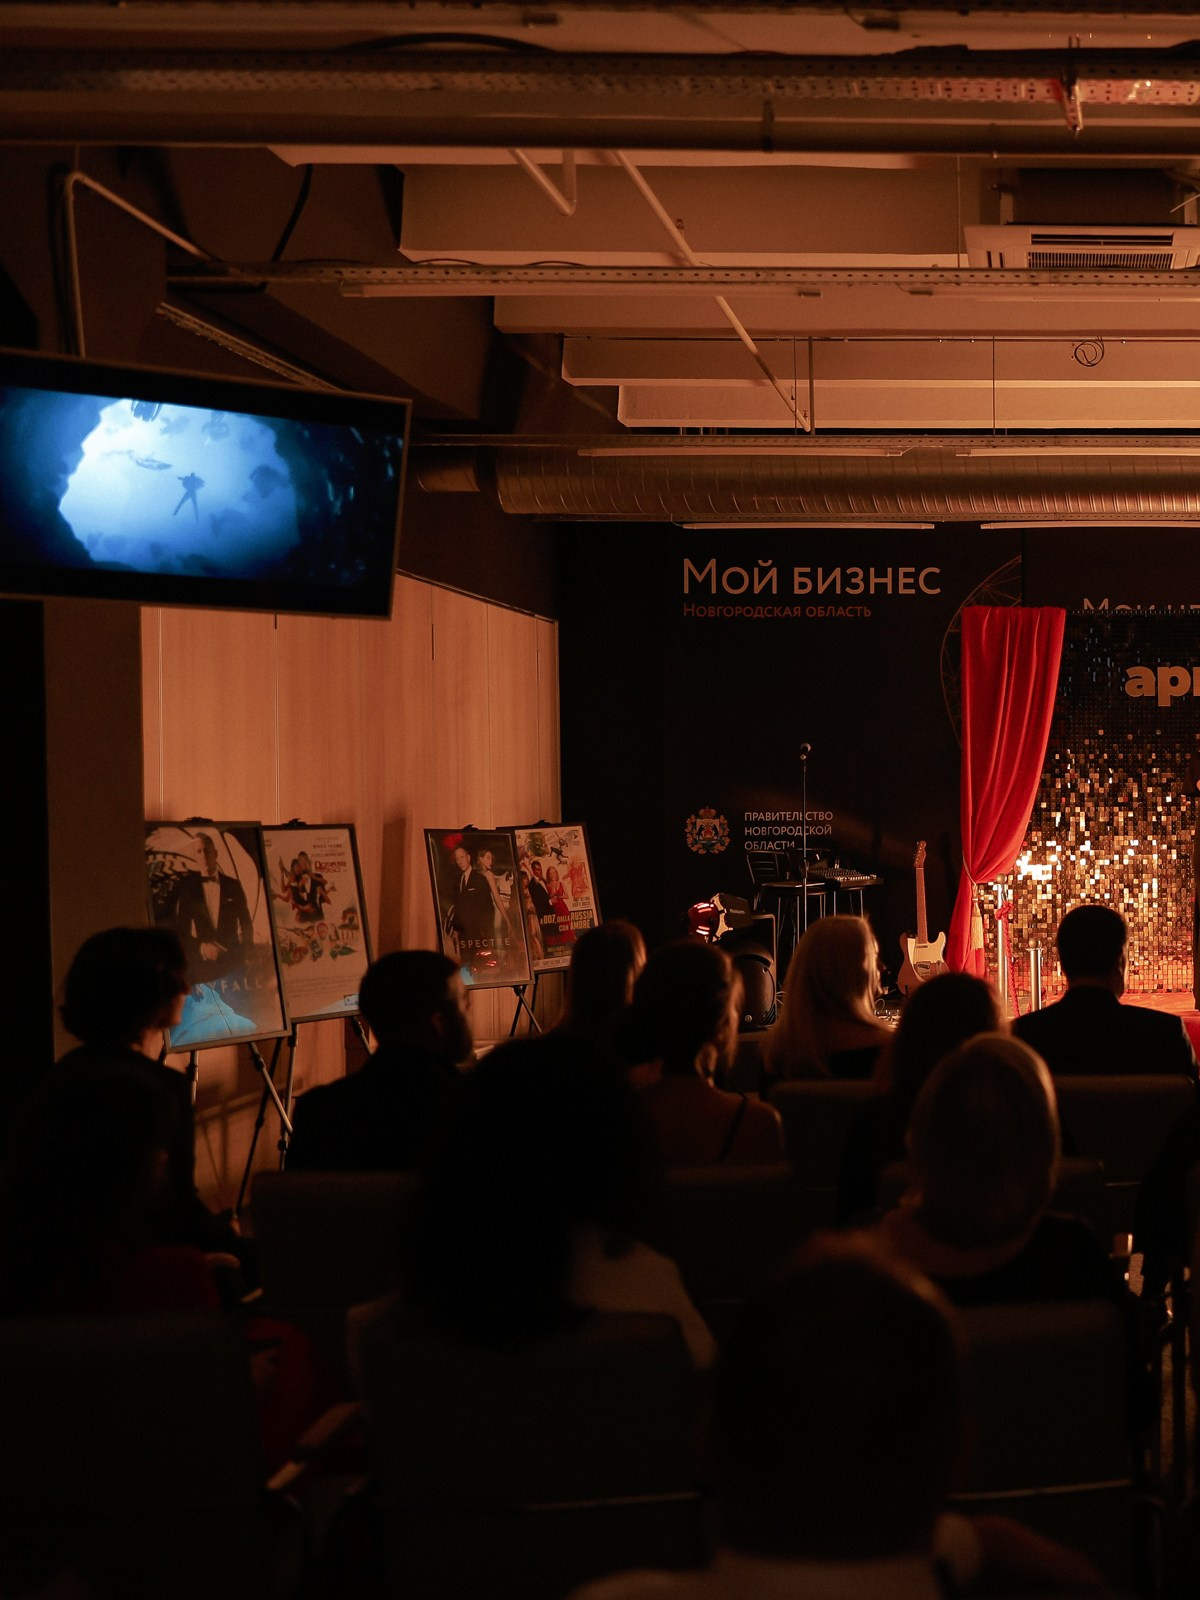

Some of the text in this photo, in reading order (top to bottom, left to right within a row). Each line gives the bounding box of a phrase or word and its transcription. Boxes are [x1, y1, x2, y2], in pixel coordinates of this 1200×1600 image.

[744, 811, 834, 822] ПРАВИТЕЛЬСТВО
[744, 840, 795, 851] ОБЛАСТИ
[570, 910, 593, 921] RUSSIA
[570, 920, 591, 931] AMORE
